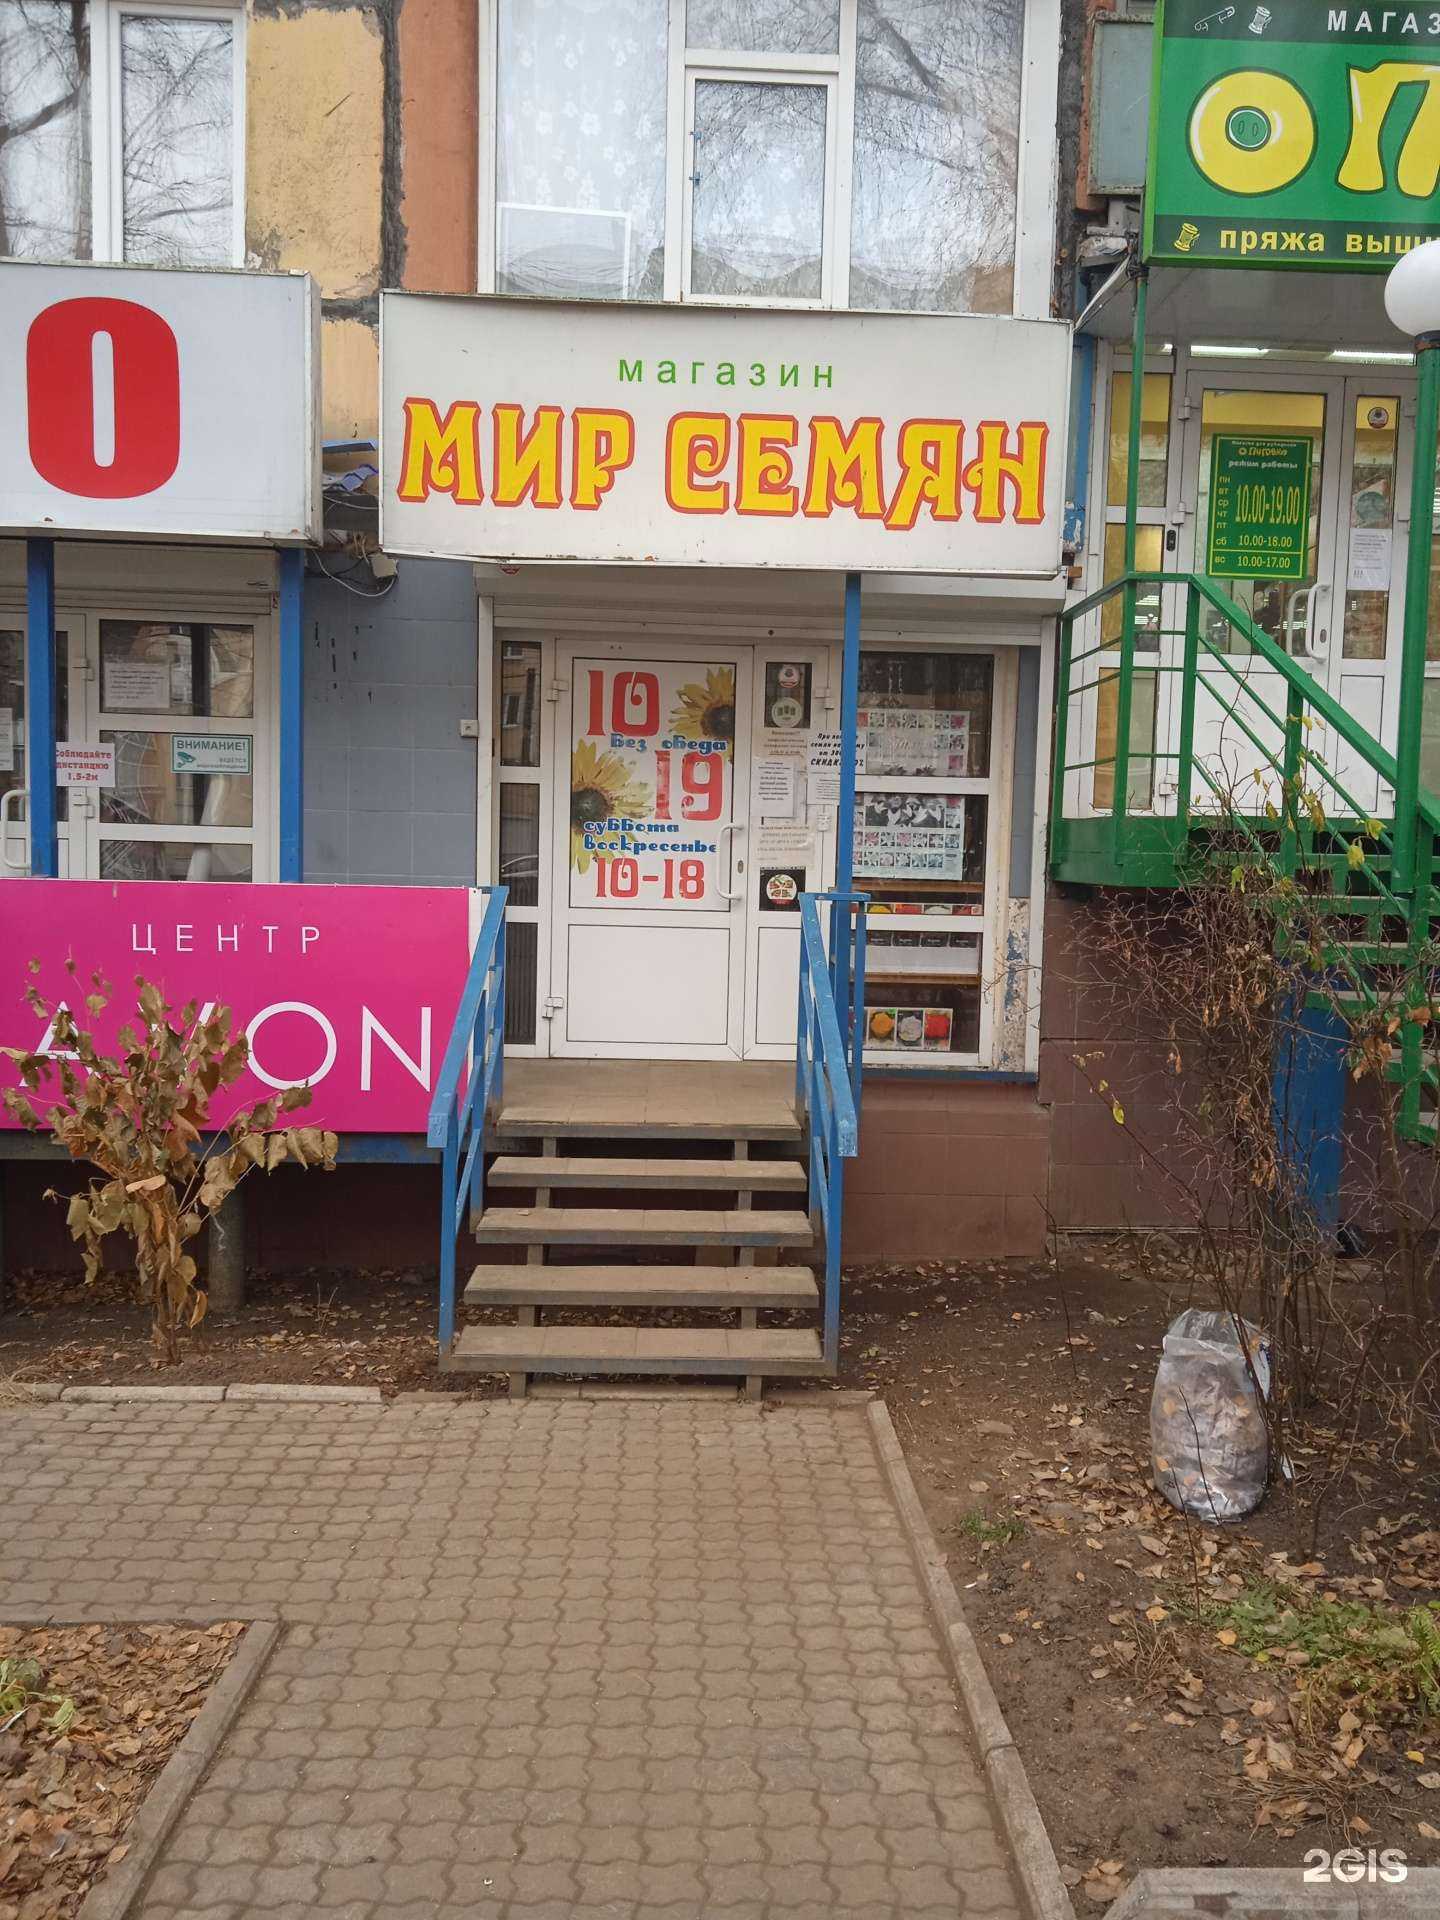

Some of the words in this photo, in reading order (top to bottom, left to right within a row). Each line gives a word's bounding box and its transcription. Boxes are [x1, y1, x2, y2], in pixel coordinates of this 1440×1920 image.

[1327, 10, 1440, 34] МАГАЗ
[1220, 229, 1325, 255] пряжа
[1346, 234, 1440, 254] выш
[619, 358, 833, 388] магазин
[397, 396, 635, 511] МИР
[665, 411, 1049, 531] СЕМЯН
[1235, 484, 1300, 524] 10.00-19.00
[1239, 535, 1293, 548] 10.00-18.00
[1237, 555, 1291, 568] 10.00-17.00
[587, 670, 660, 736] 10
[55, 750, 112, 759] Соблюдайте
[176, 740, 246, 751] ВНИМАНИЕ!
[661, 735, 729, 754] обеда
[811, 758, 841, 767] СКИДК
[655, 750, 724, 821] 19
[584, 819, 679, 836] суббота
[584, 835, 717, 855] воскресенье
[595, 857, 704, 899] 10-18
[132, 923, 321, 955] ЦЕНТР
